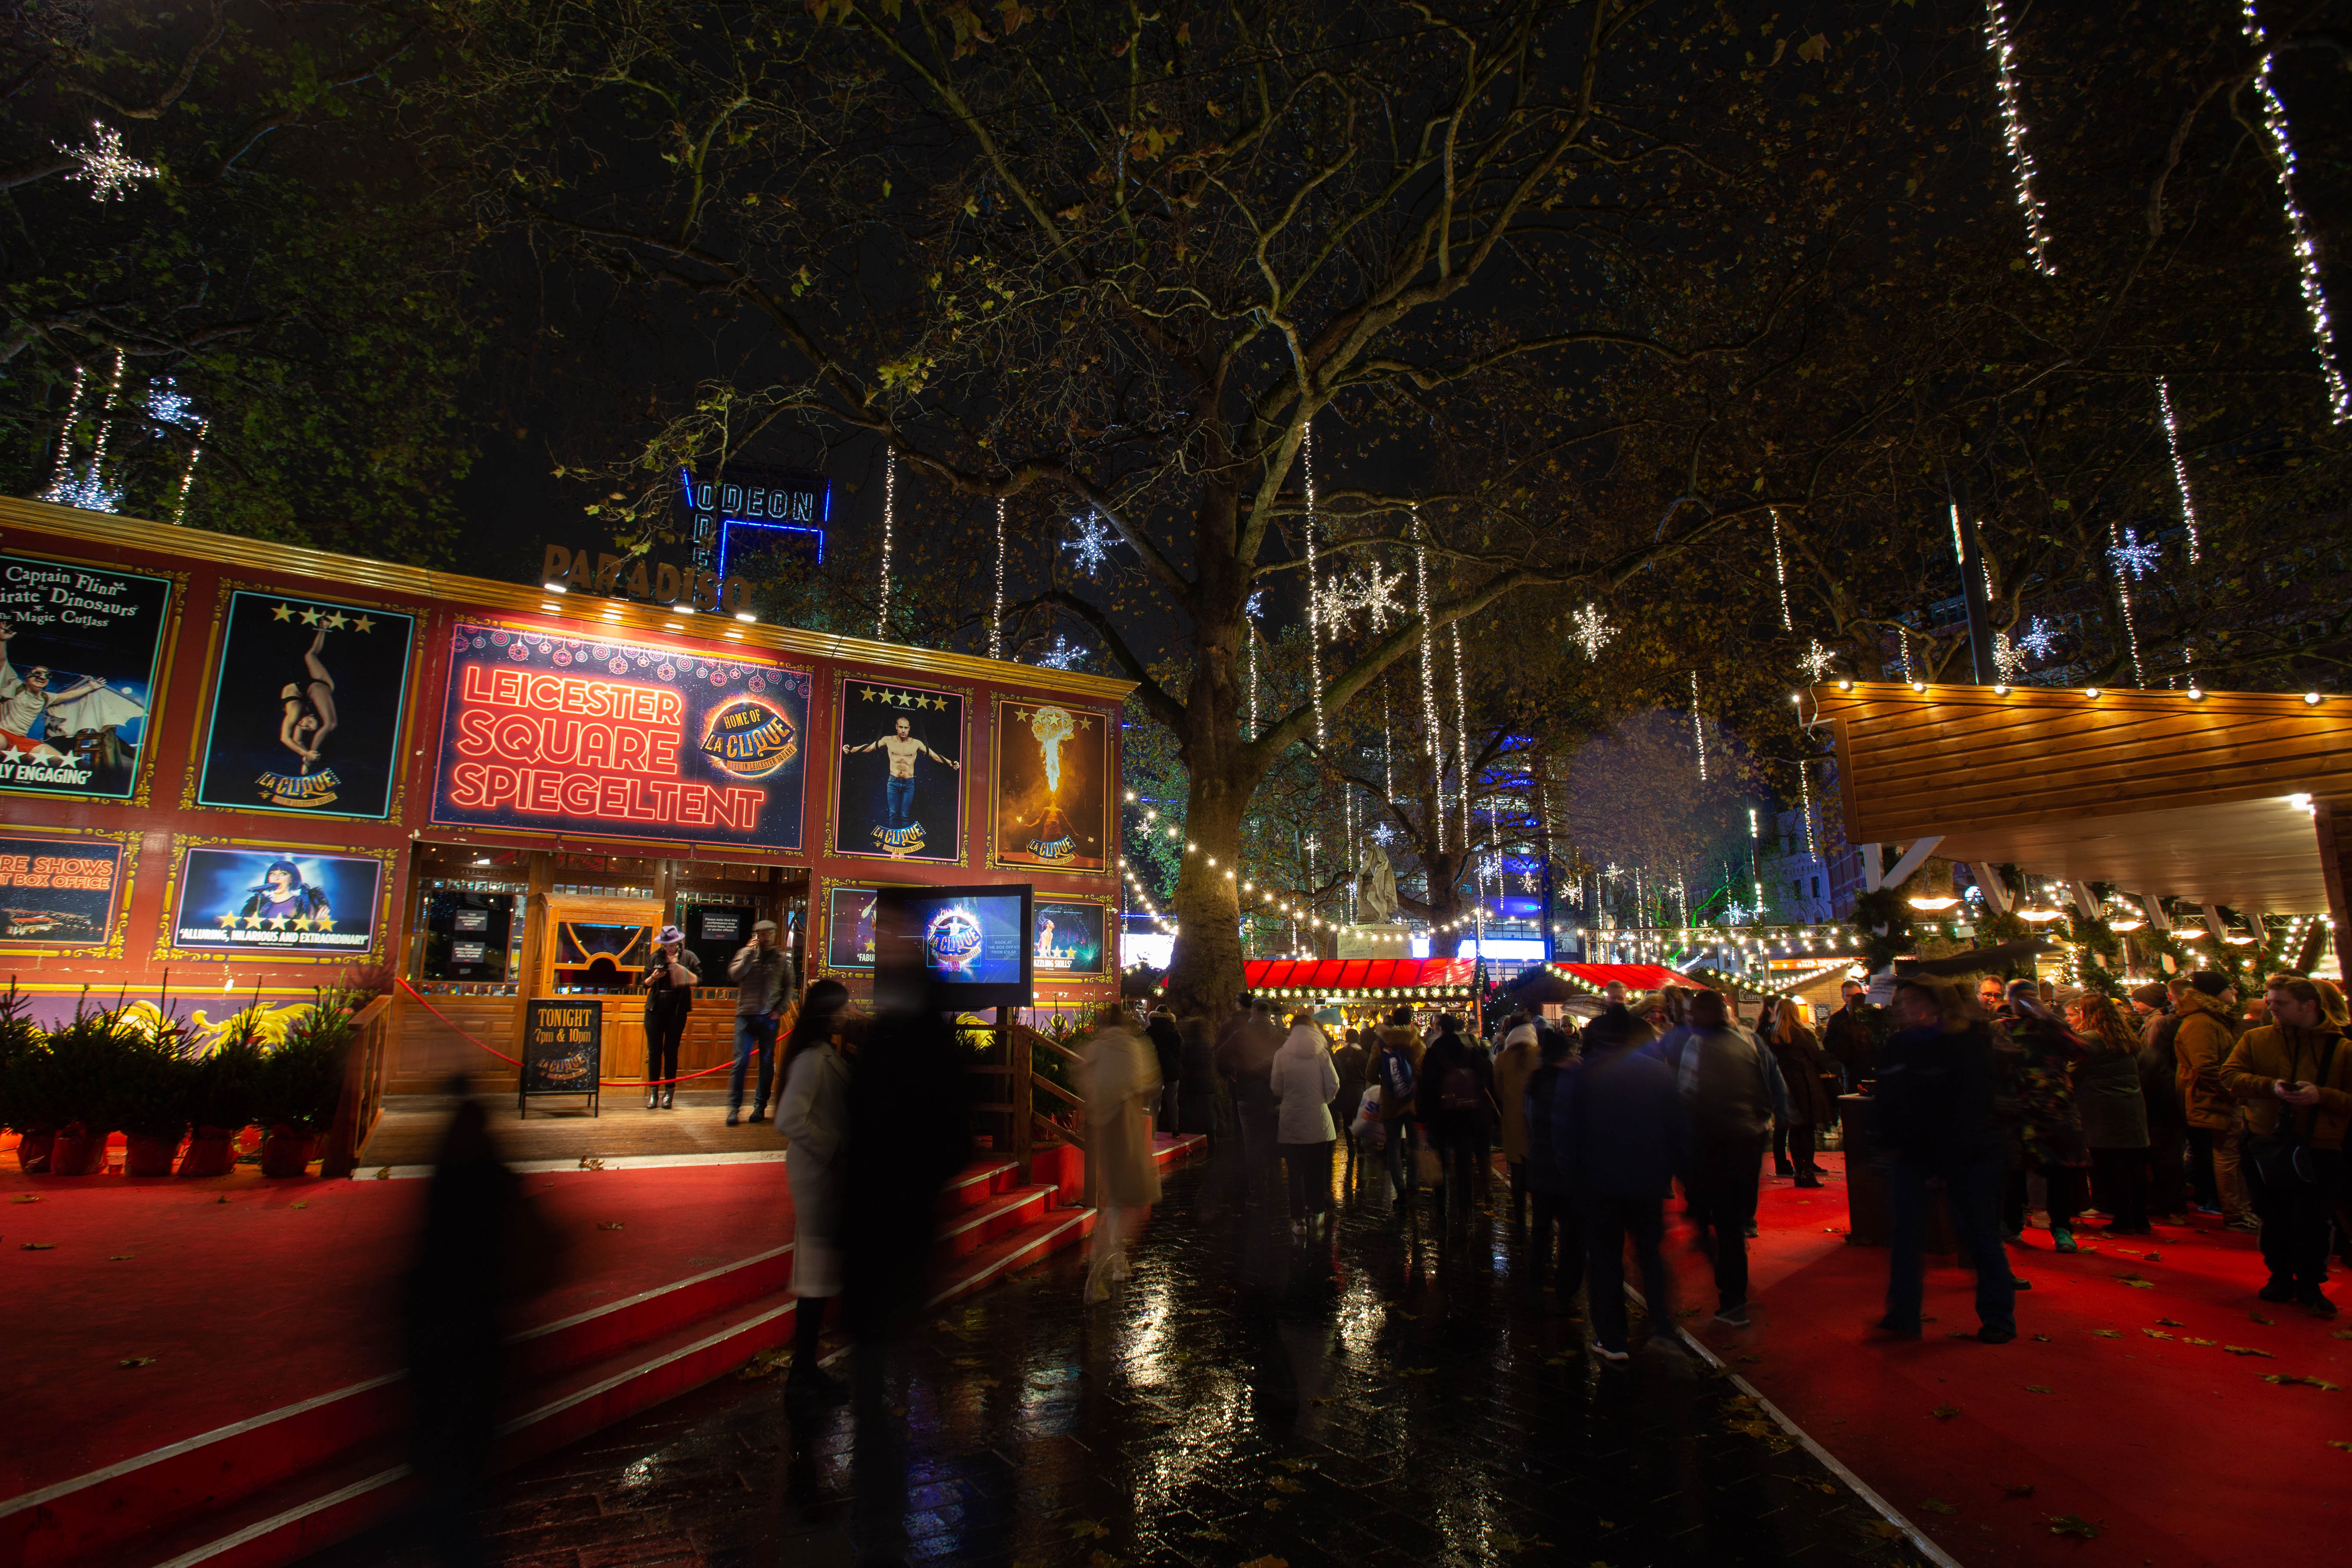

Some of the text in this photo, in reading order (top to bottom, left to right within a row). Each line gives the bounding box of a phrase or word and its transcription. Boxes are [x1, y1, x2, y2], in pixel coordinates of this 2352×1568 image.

[697, 481, 813, 521] ODEON
[5, 566, 118, 596] Captain Flinn
[542, 543, 752, 614] PARADISO
[49, 587, 137, 616] Dinosaurs
[14, 611, 56, 625] Magic
[60, 610, 109, 627] Cutlass
[463, 666, 682, 726] LEICESTER
[723, 709, 761, 729] HOME OF
[457, 710, 680, 776] SQUARE
[705, 717, 790, 758] LA CLIQUE
[750, 758, 777, 770] LEICESTER
[778, 747, 795, 763] SQUARE
[259, 771, 336, 798] LA CLIQUE
[451, 763, 765, 828] SPIEGELTENT
[873, 824, 923, 846] LA CLIQUE
[1029, 837, 1073, 858] LA CLIQUE
[33, 857, 113, 876] SHOWS
[13, 874, 50, 887] BOX
[52, 875, 111, 889] OFFICE
[231, 930, 278, 942] HILARIOUS
[278, 931, 299, 942] AND
[929, 926, 979, 953] LA CLIQUE
[537, 1008, 592, 1027] TONIGHT
[535, 1028, 591, 1044] 7pm & 10pm
[538, 1054, 585, 1073] LA CLIQUE
